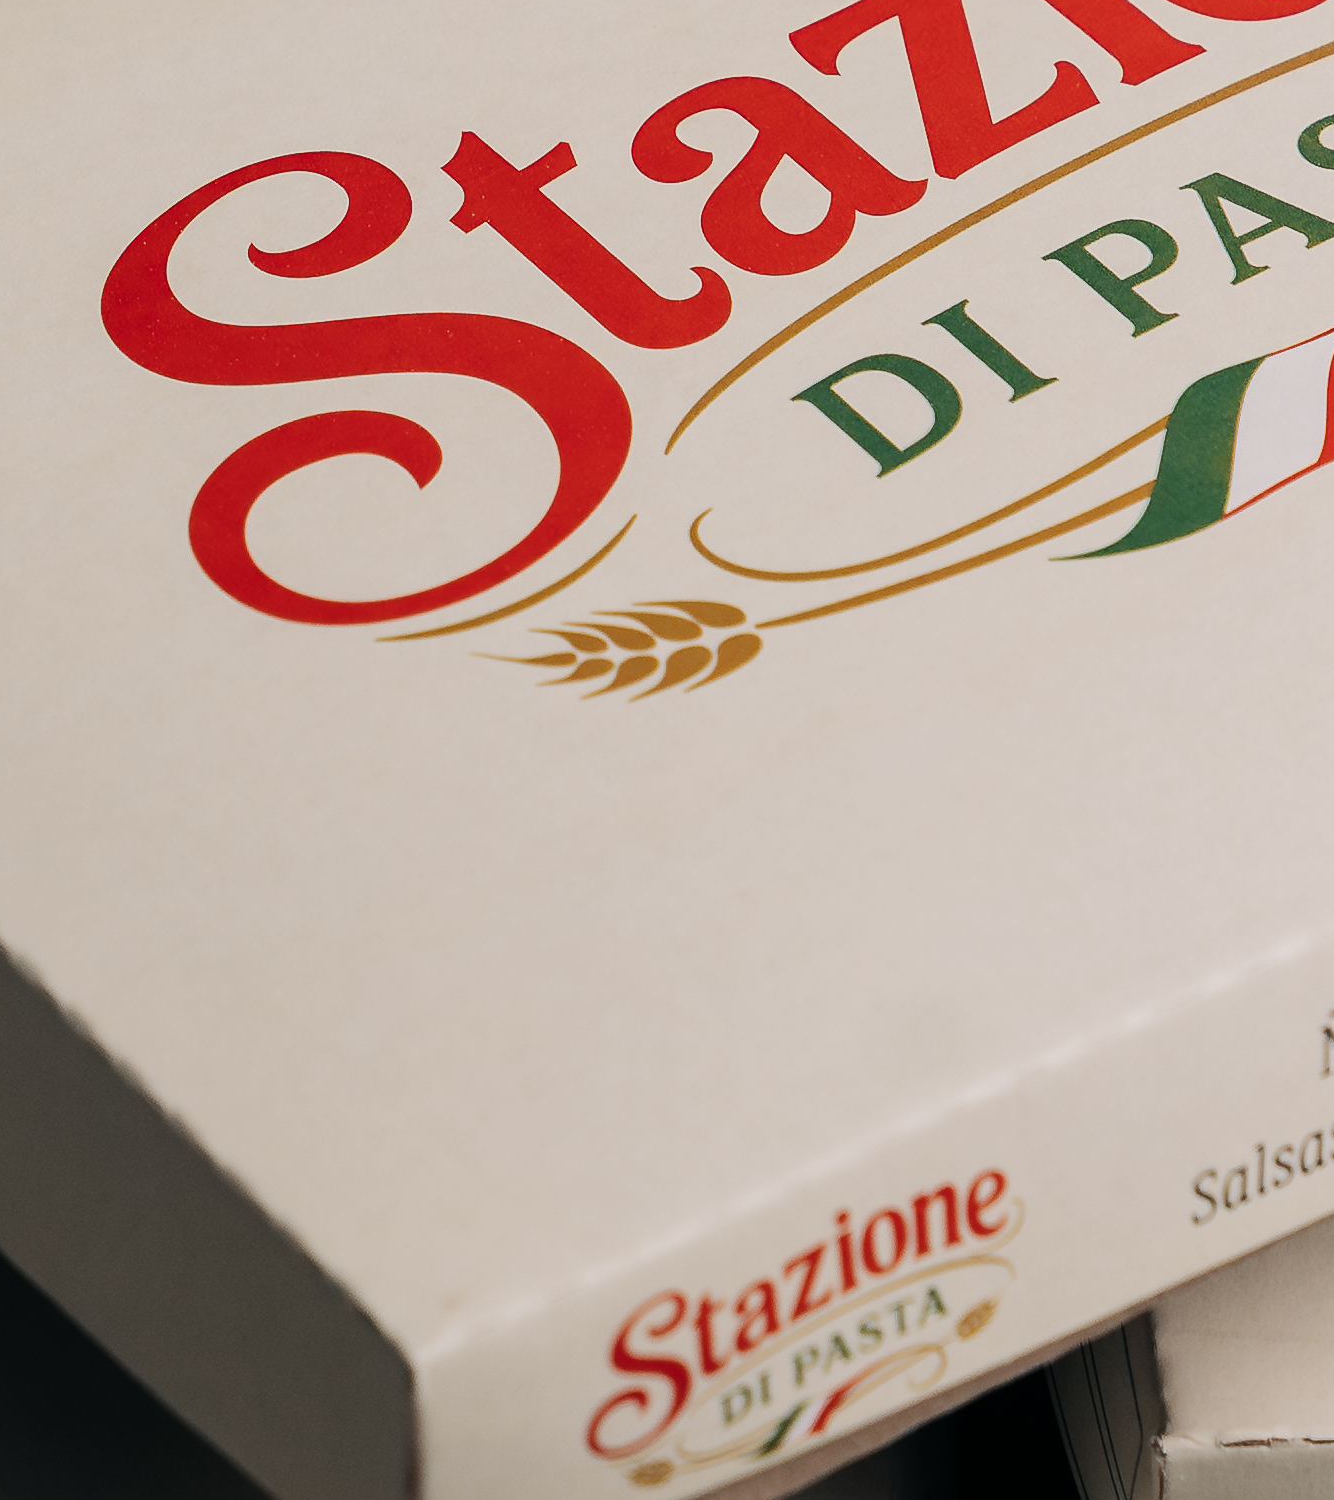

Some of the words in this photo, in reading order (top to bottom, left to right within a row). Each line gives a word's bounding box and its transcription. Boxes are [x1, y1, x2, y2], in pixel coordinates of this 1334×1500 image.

[792, 298, 1058, 478] DI
[585, 1167, 1009, 1462] Stazione
[719, 1370, 774, 1426] DI
[790, 1284, 948, 1387] PASTA
